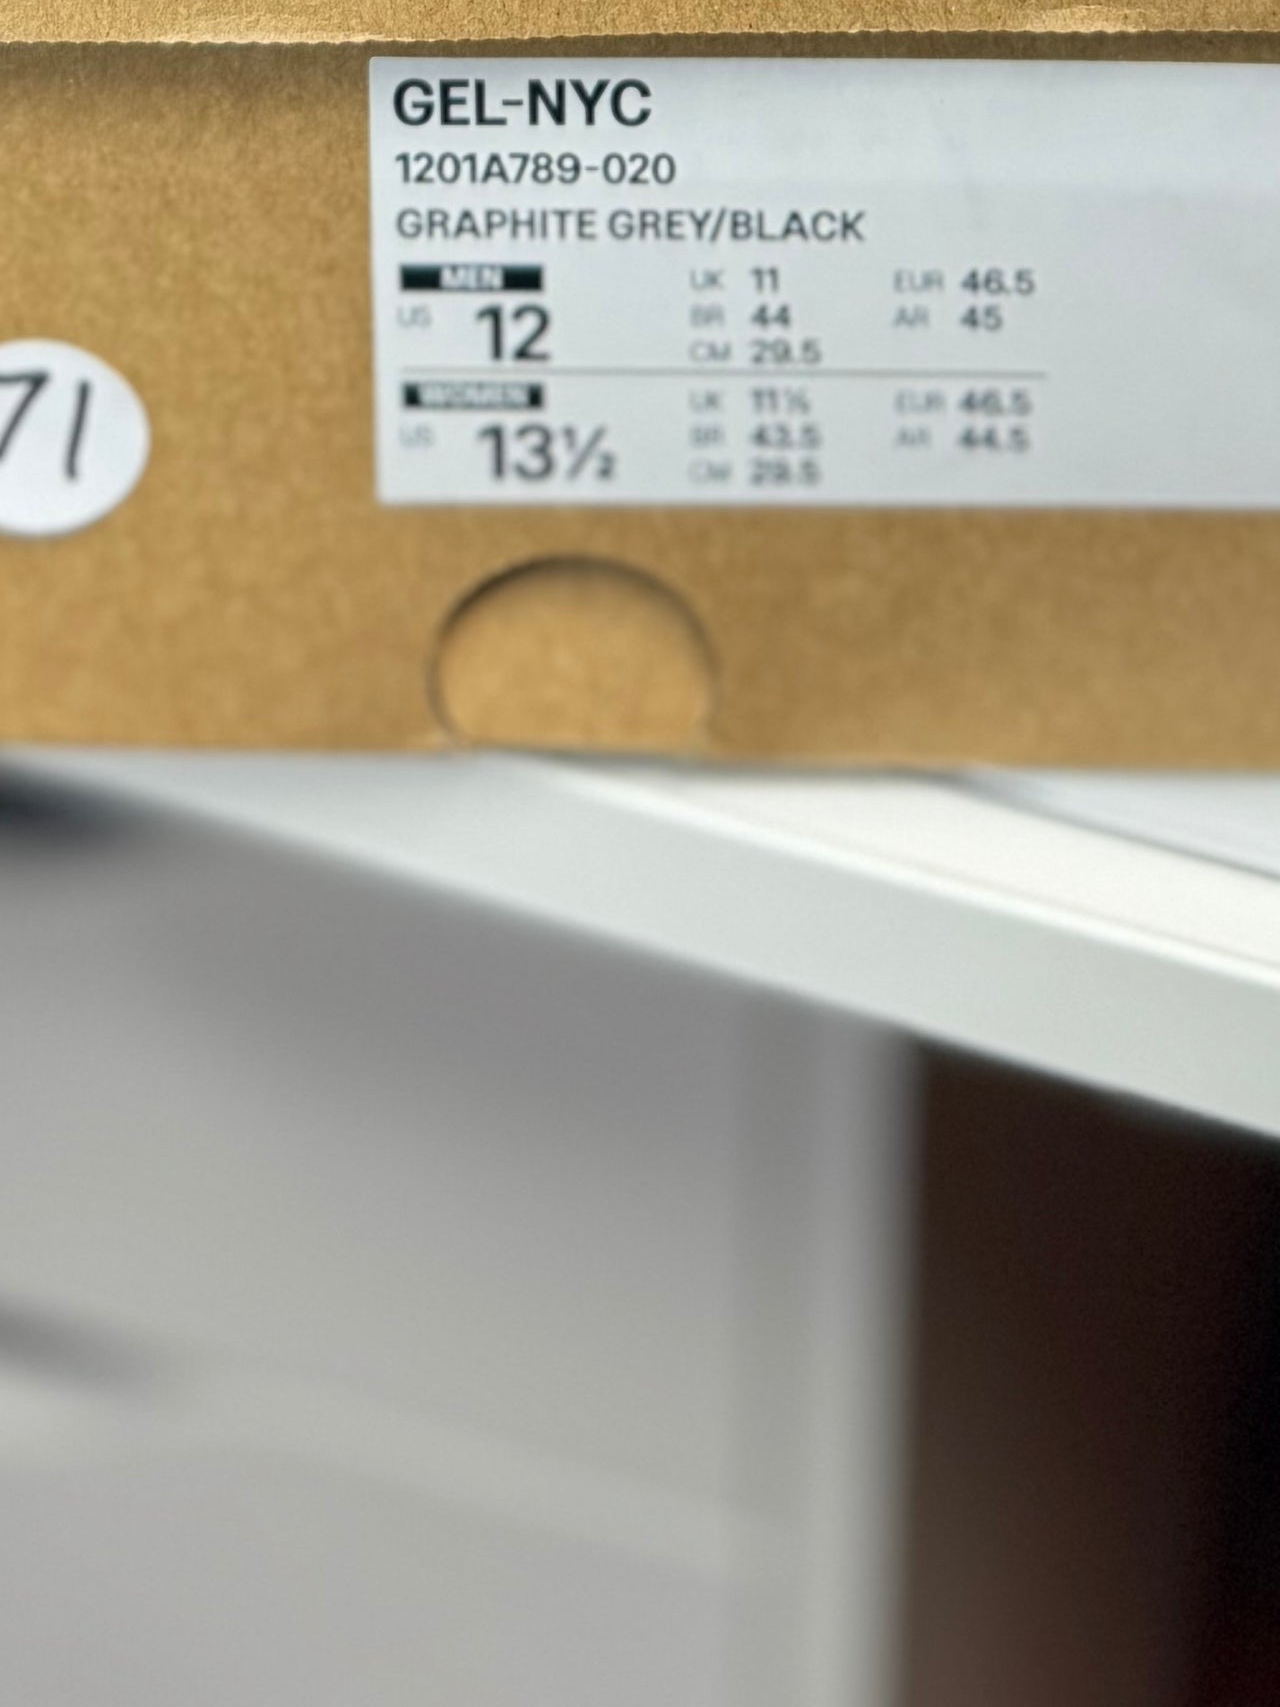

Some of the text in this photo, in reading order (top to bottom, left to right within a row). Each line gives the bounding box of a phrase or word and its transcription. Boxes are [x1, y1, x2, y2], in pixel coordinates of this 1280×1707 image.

[391, 76, 653, 128] GEL-NYC
[394, 150, 678, 187] 1201A789-020
[394, 206, 866, 244] GRAPHITE GREY/BLACK
[688, 266, 781, 293] UK 11
[891, 267, 1037, 298] EUR 46.5
[750, 303, 793, 330] 44
[959, 303, 1005, 333] 45
[475, 302, 552, 363] 12
[749, 337, 824, 367] 29.5
